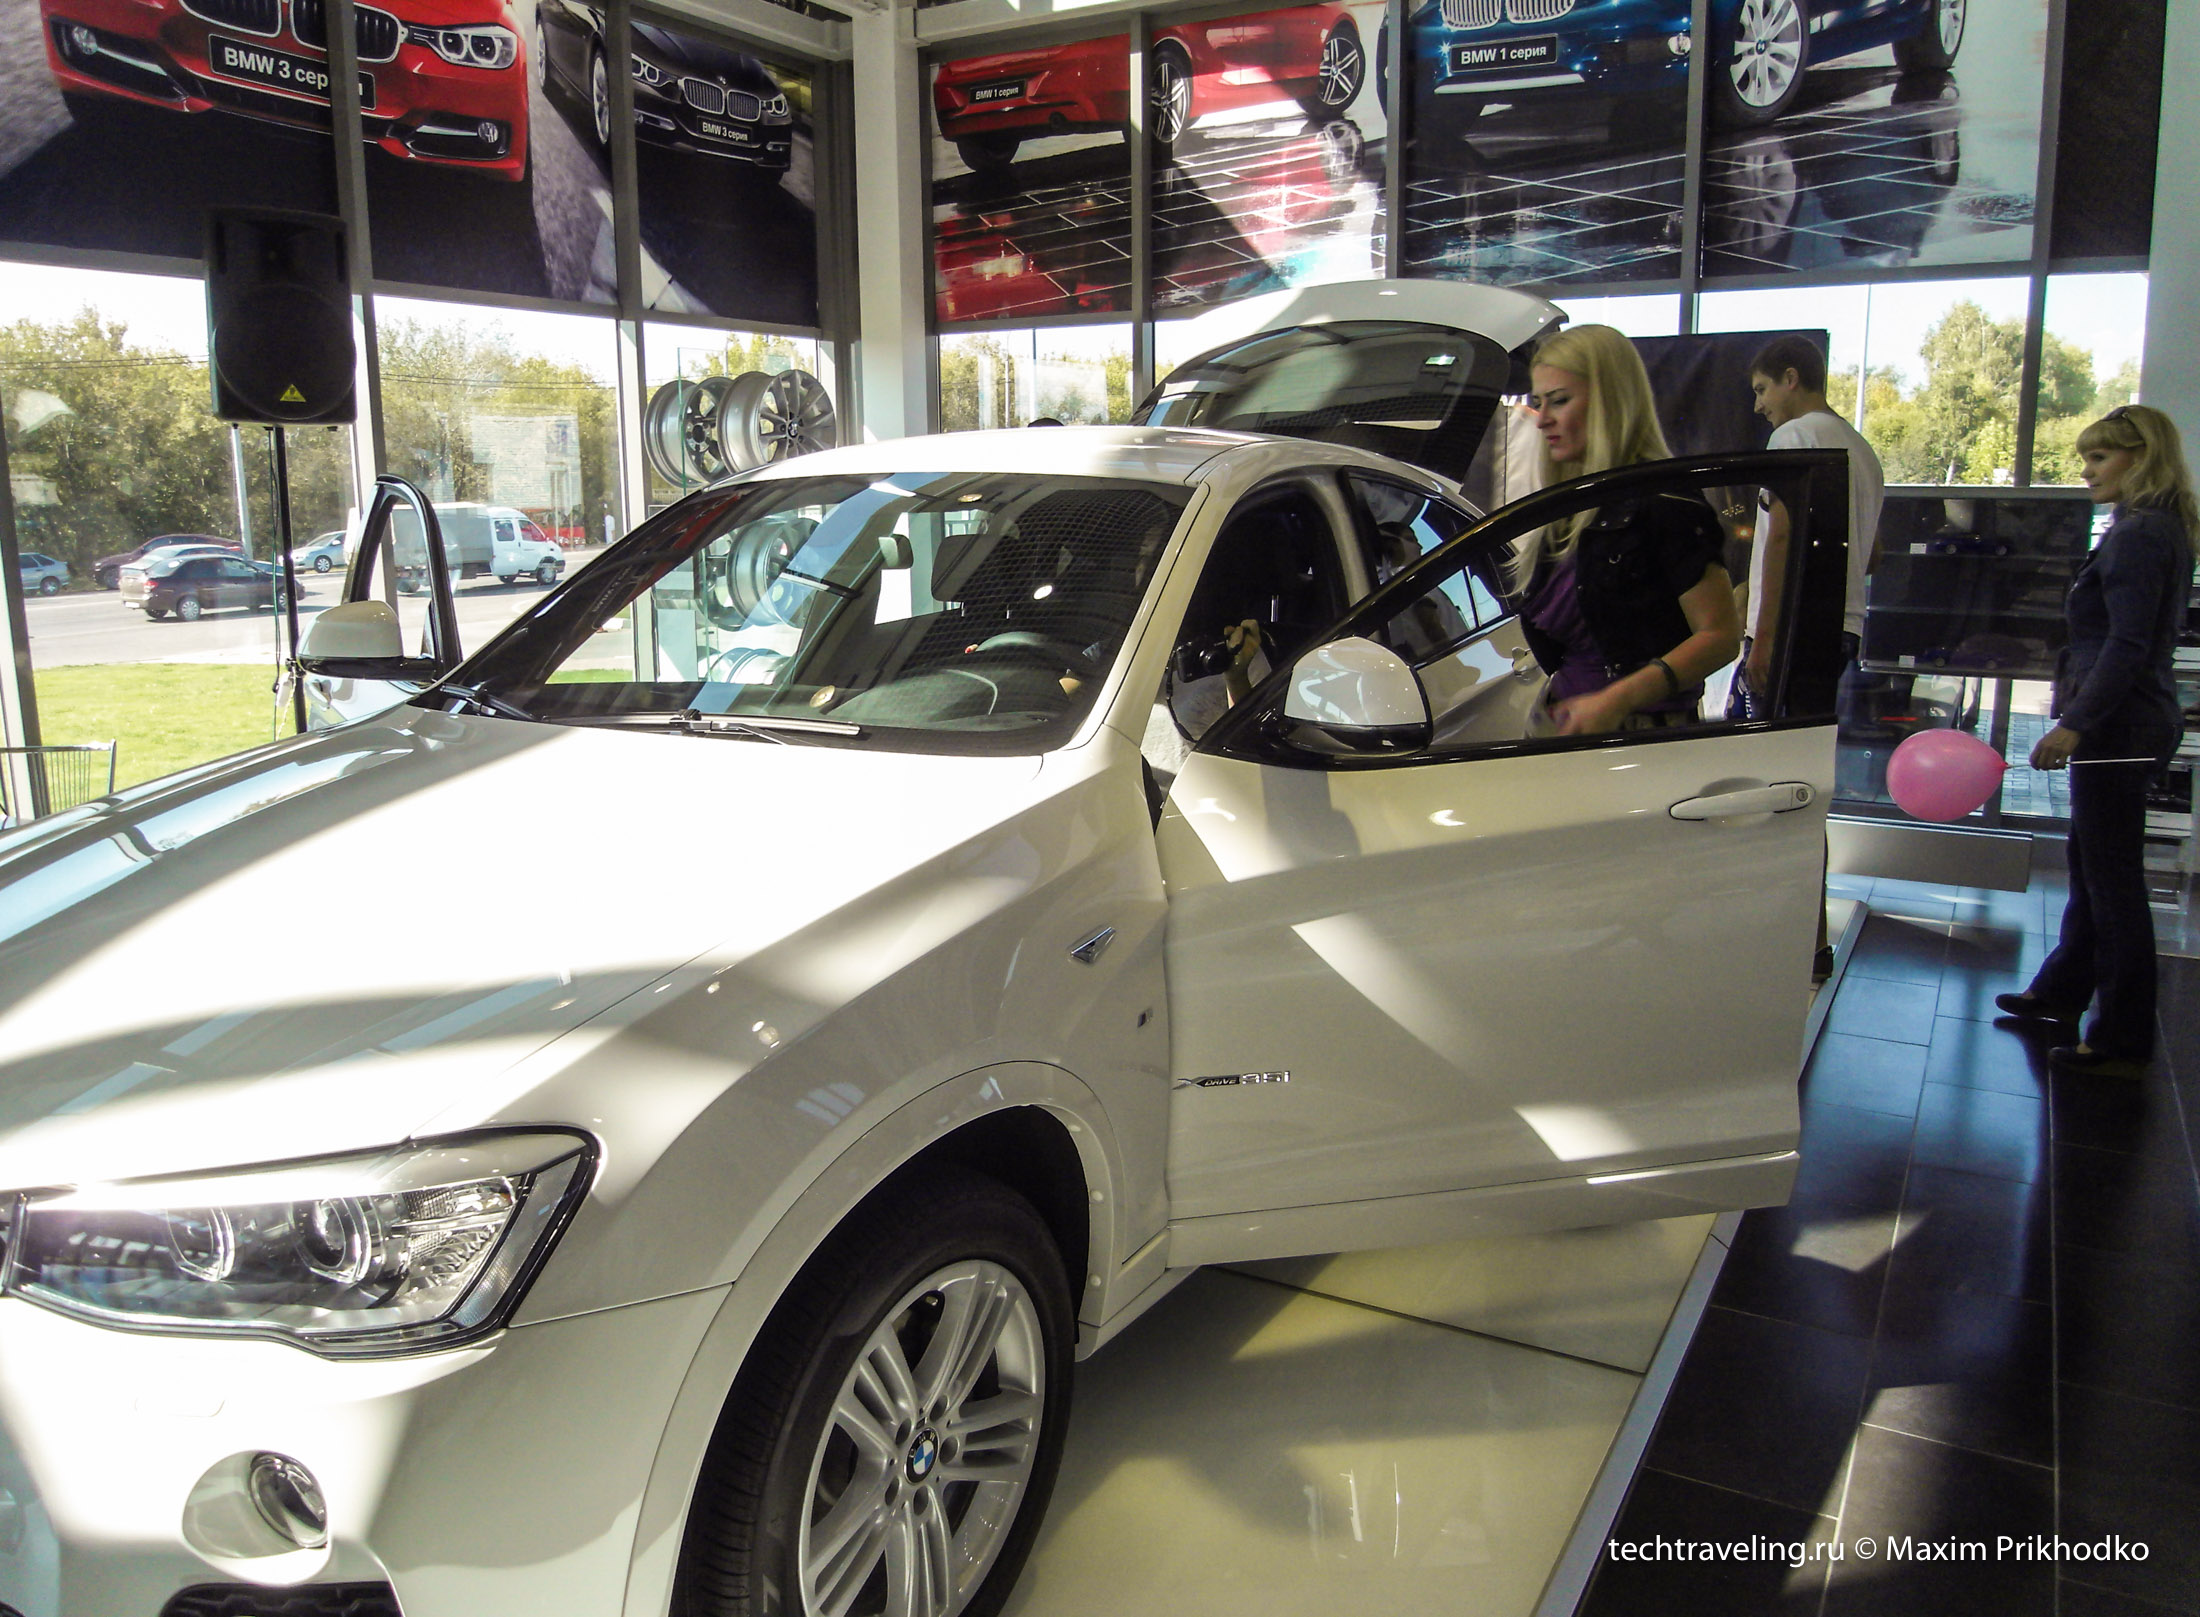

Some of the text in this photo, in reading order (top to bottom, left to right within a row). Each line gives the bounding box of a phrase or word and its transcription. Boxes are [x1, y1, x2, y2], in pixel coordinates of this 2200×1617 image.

[224, 47, 274, 75] BMW
[279, 60, 291, 79] 3
[1461, 46, 1547, 64] BMW 1 серия
[976, 89, 993, 100] BMW
[999, 87, 1019, 97] серия
[702, 121, 748, 141] BMW 3 серия
